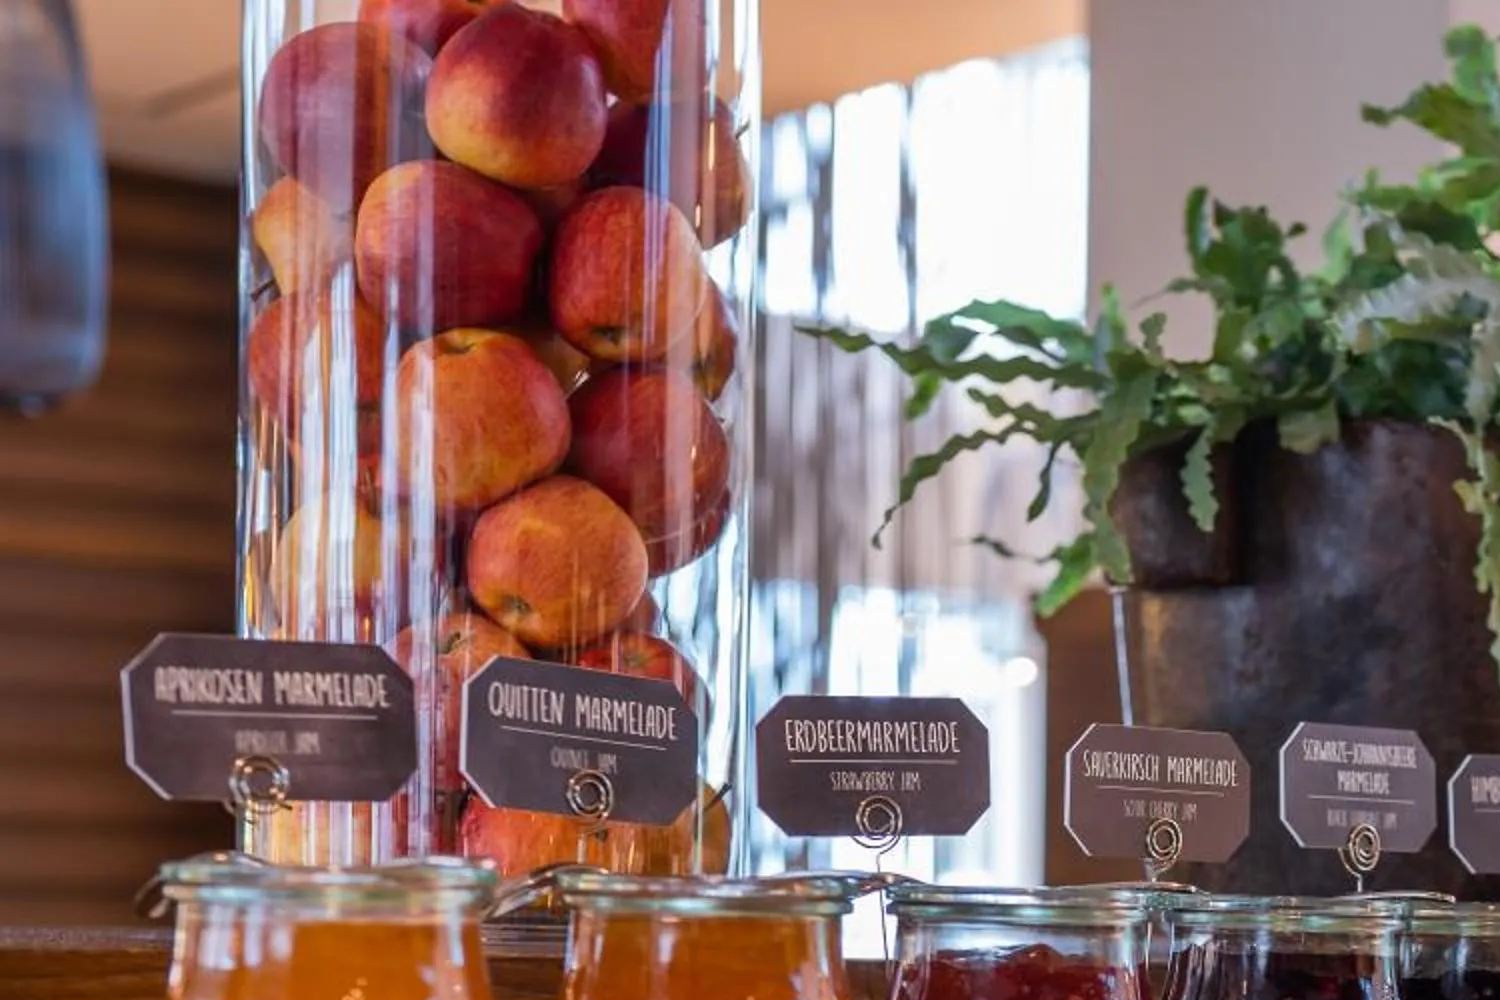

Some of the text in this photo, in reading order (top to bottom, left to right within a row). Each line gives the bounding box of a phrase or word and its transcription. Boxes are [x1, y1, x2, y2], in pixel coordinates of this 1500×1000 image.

[273, 670, 391, 708] MARMELADE
[487, 681, 679, 741] QUITTEN MARMELADE
[784, 719, 961, 753] ERDBEERMARMELADE
[829, 770, 922, 792] STRAWBERRY JAM
[1083, 749, 1240, 788] SAUERKIRSCH MARMELADE
